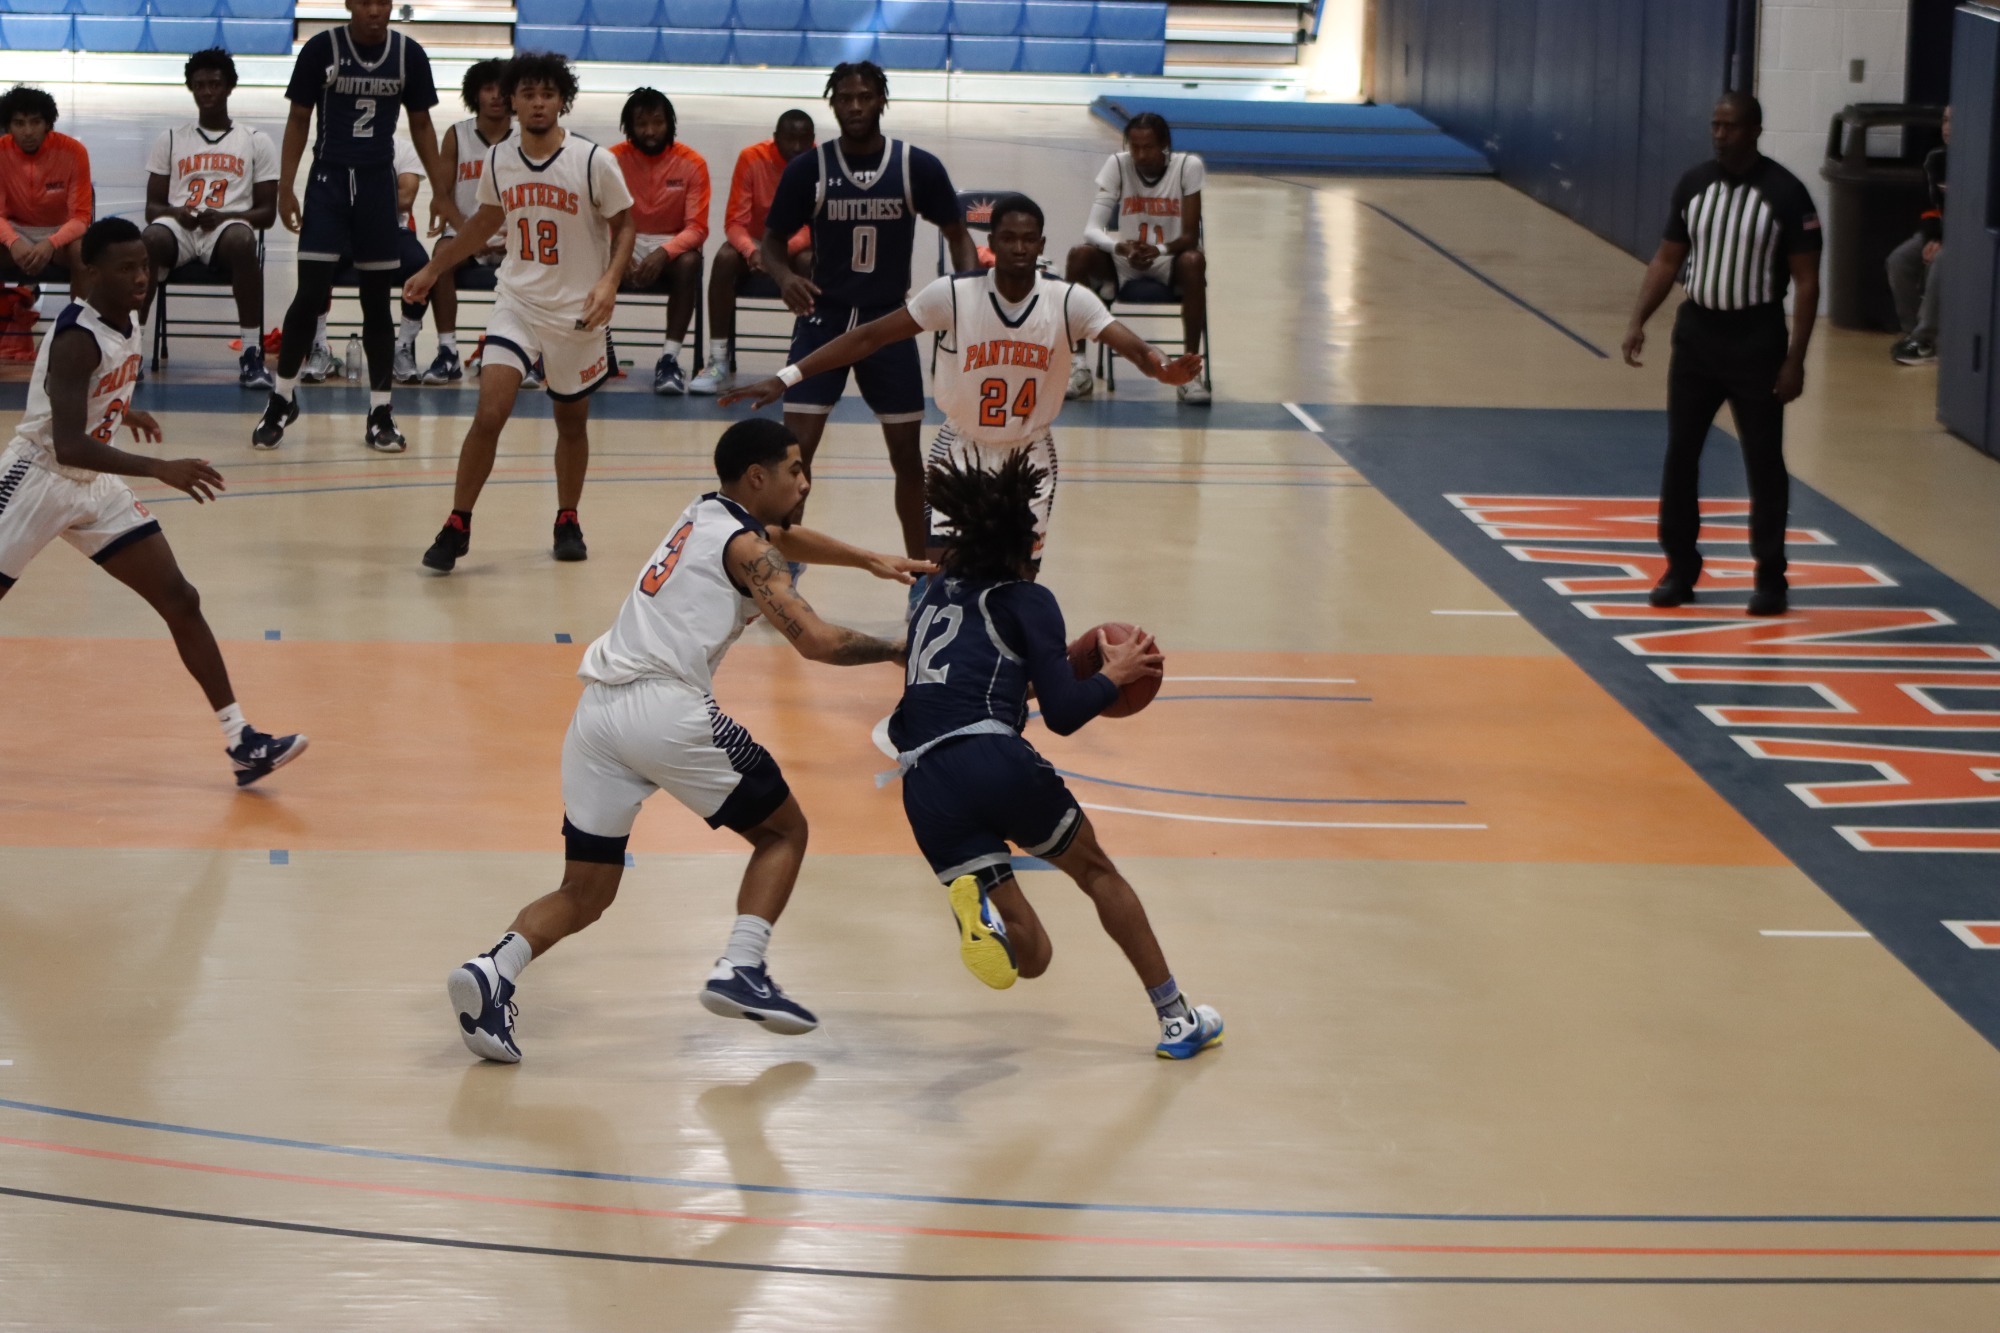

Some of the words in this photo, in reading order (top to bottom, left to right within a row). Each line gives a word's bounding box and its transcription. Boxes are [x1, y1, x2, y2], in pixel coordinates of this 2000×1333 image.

[335, 76, 401, 96] DUTCHESS
[352, 99, 376, 137] 2
[178, 153, 245, 180] PANTHERS
[184, 178, 228, 209] 33
[501, 182, 579, 215] PANTHERS
[827, 198, 903, 221] DUTCHESS
[517, 217, 558, 265] 12
[851, 226, 877, 273] 0
[963, 339, 1055, 373] PANTHER
[979, 377, 1036, 428] 24
[639, 520, 694, 598] 3
[906, 603, 964, 686] 12
